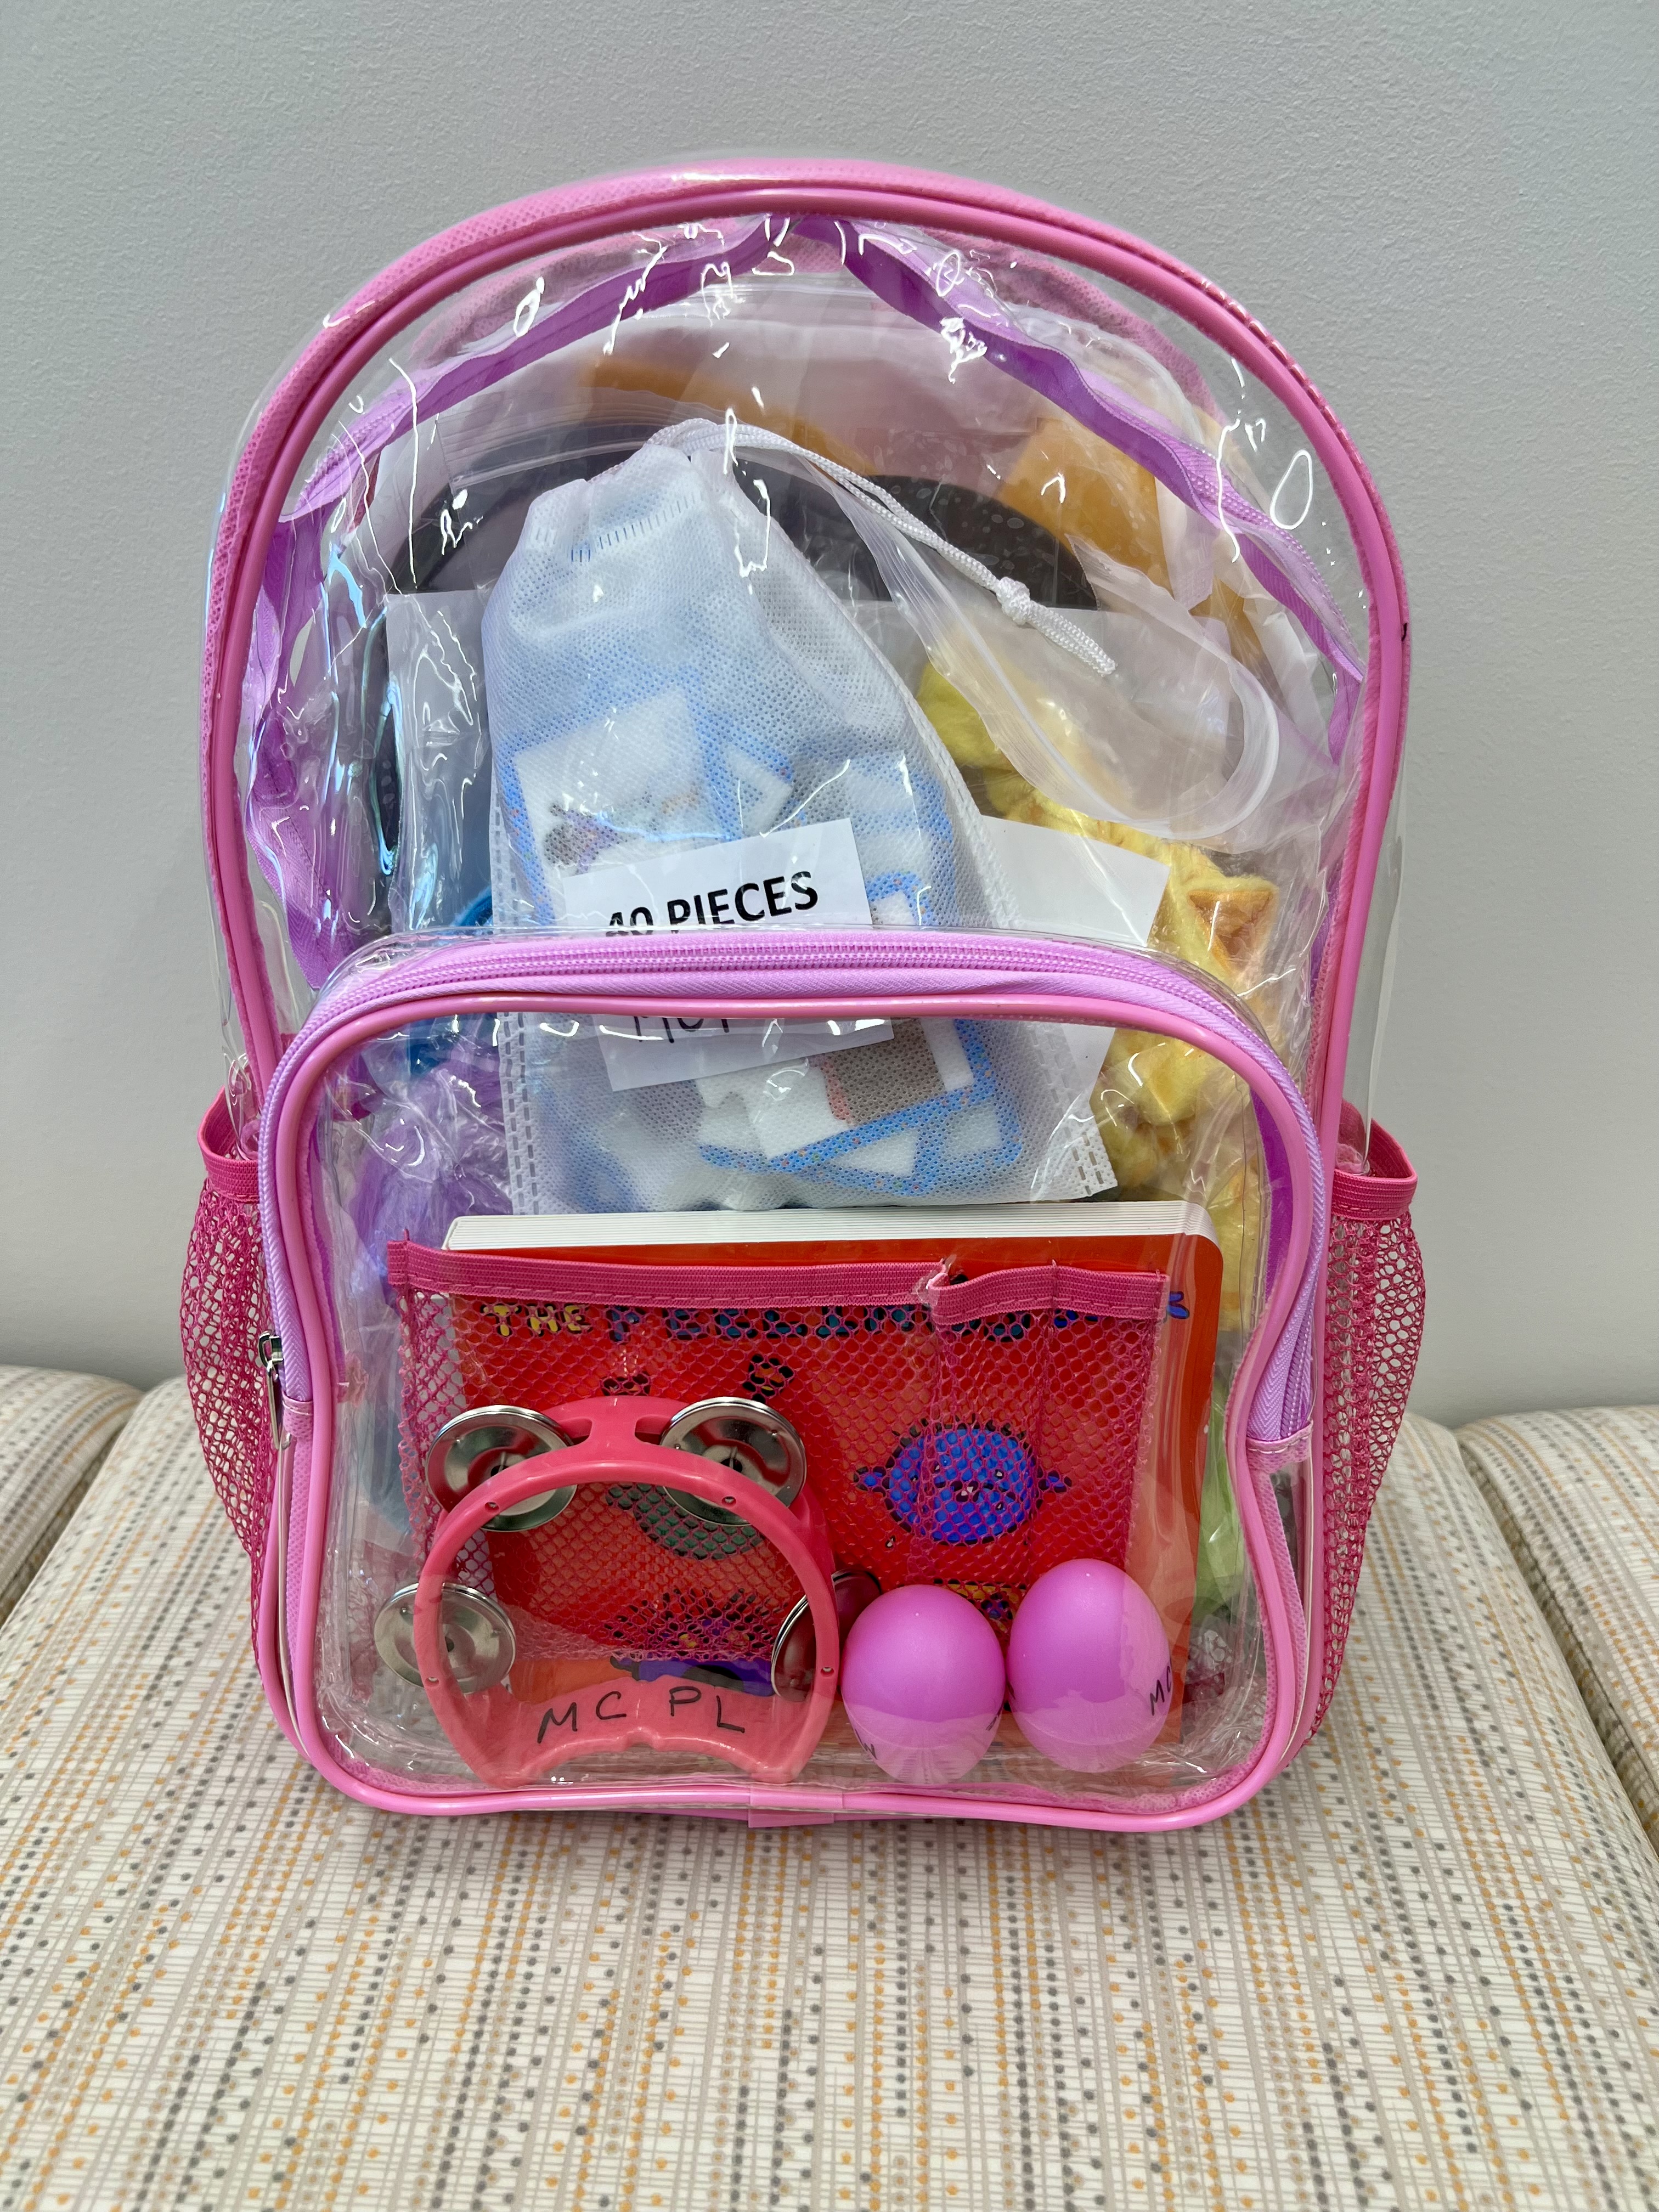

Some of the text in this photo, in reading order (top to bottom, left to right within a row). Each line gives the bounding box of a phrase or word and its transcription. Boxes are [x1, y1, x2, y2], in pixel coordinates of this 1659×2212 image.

[605, 871, 819, 937] 40 PIECES
[479, 1301, 594, 1338] THE
